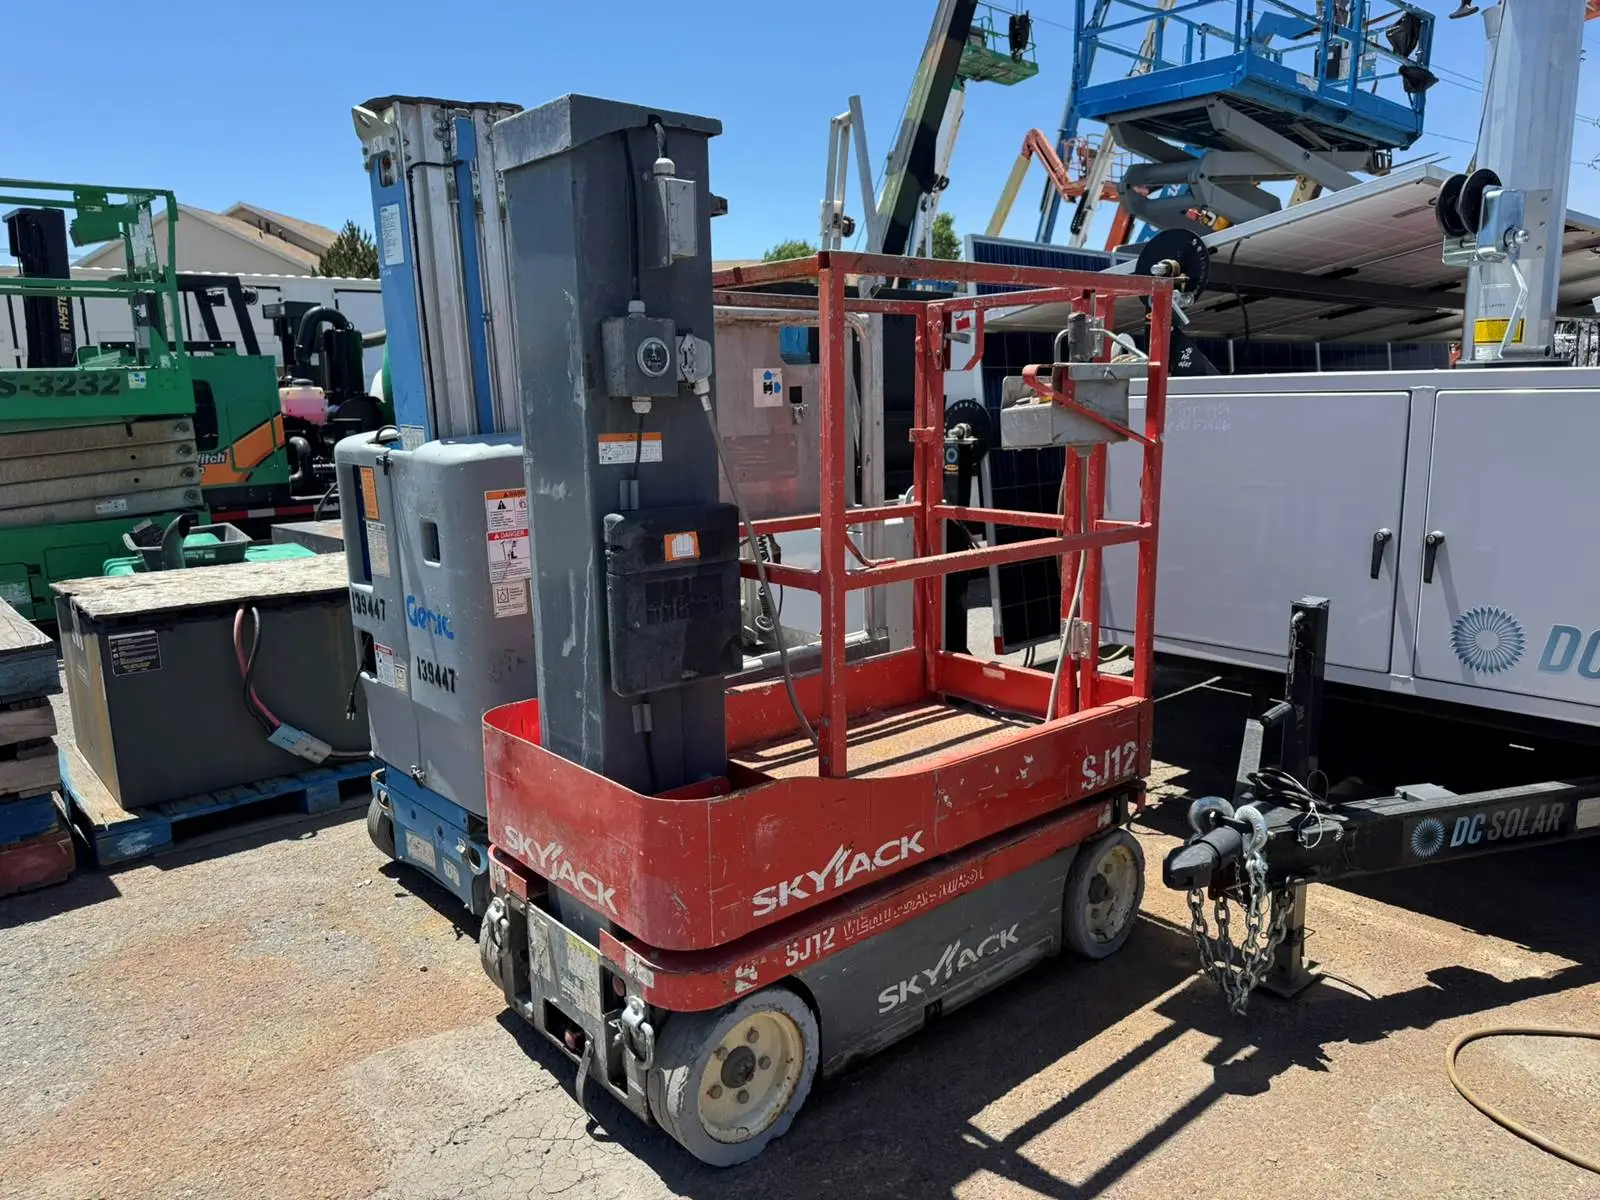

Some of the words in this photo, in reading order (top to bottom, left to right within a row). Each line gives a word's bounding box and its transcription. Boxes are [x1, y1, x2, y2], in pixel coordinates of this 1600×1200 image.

[57, 287, 70, 330] HYSTE
[0, 373, 120, 397] S-3232
[198, 453, 226, 465] itch
[351, 591, 386, 621] 139447
[416, 656, 456, 694] 139447
[1081, 740, 1139, 790] SJ12
[1450, 813, 1487, 848] DC
[1487, 802, 1566, 841] SOLAR
[504, 825, 618, 916] SKYJACK
[752, 830, 926, 917] SKYJACK
[785, 926, 836, 967] SJ12
[878, 922, 1020, 1014] SKYJACK
